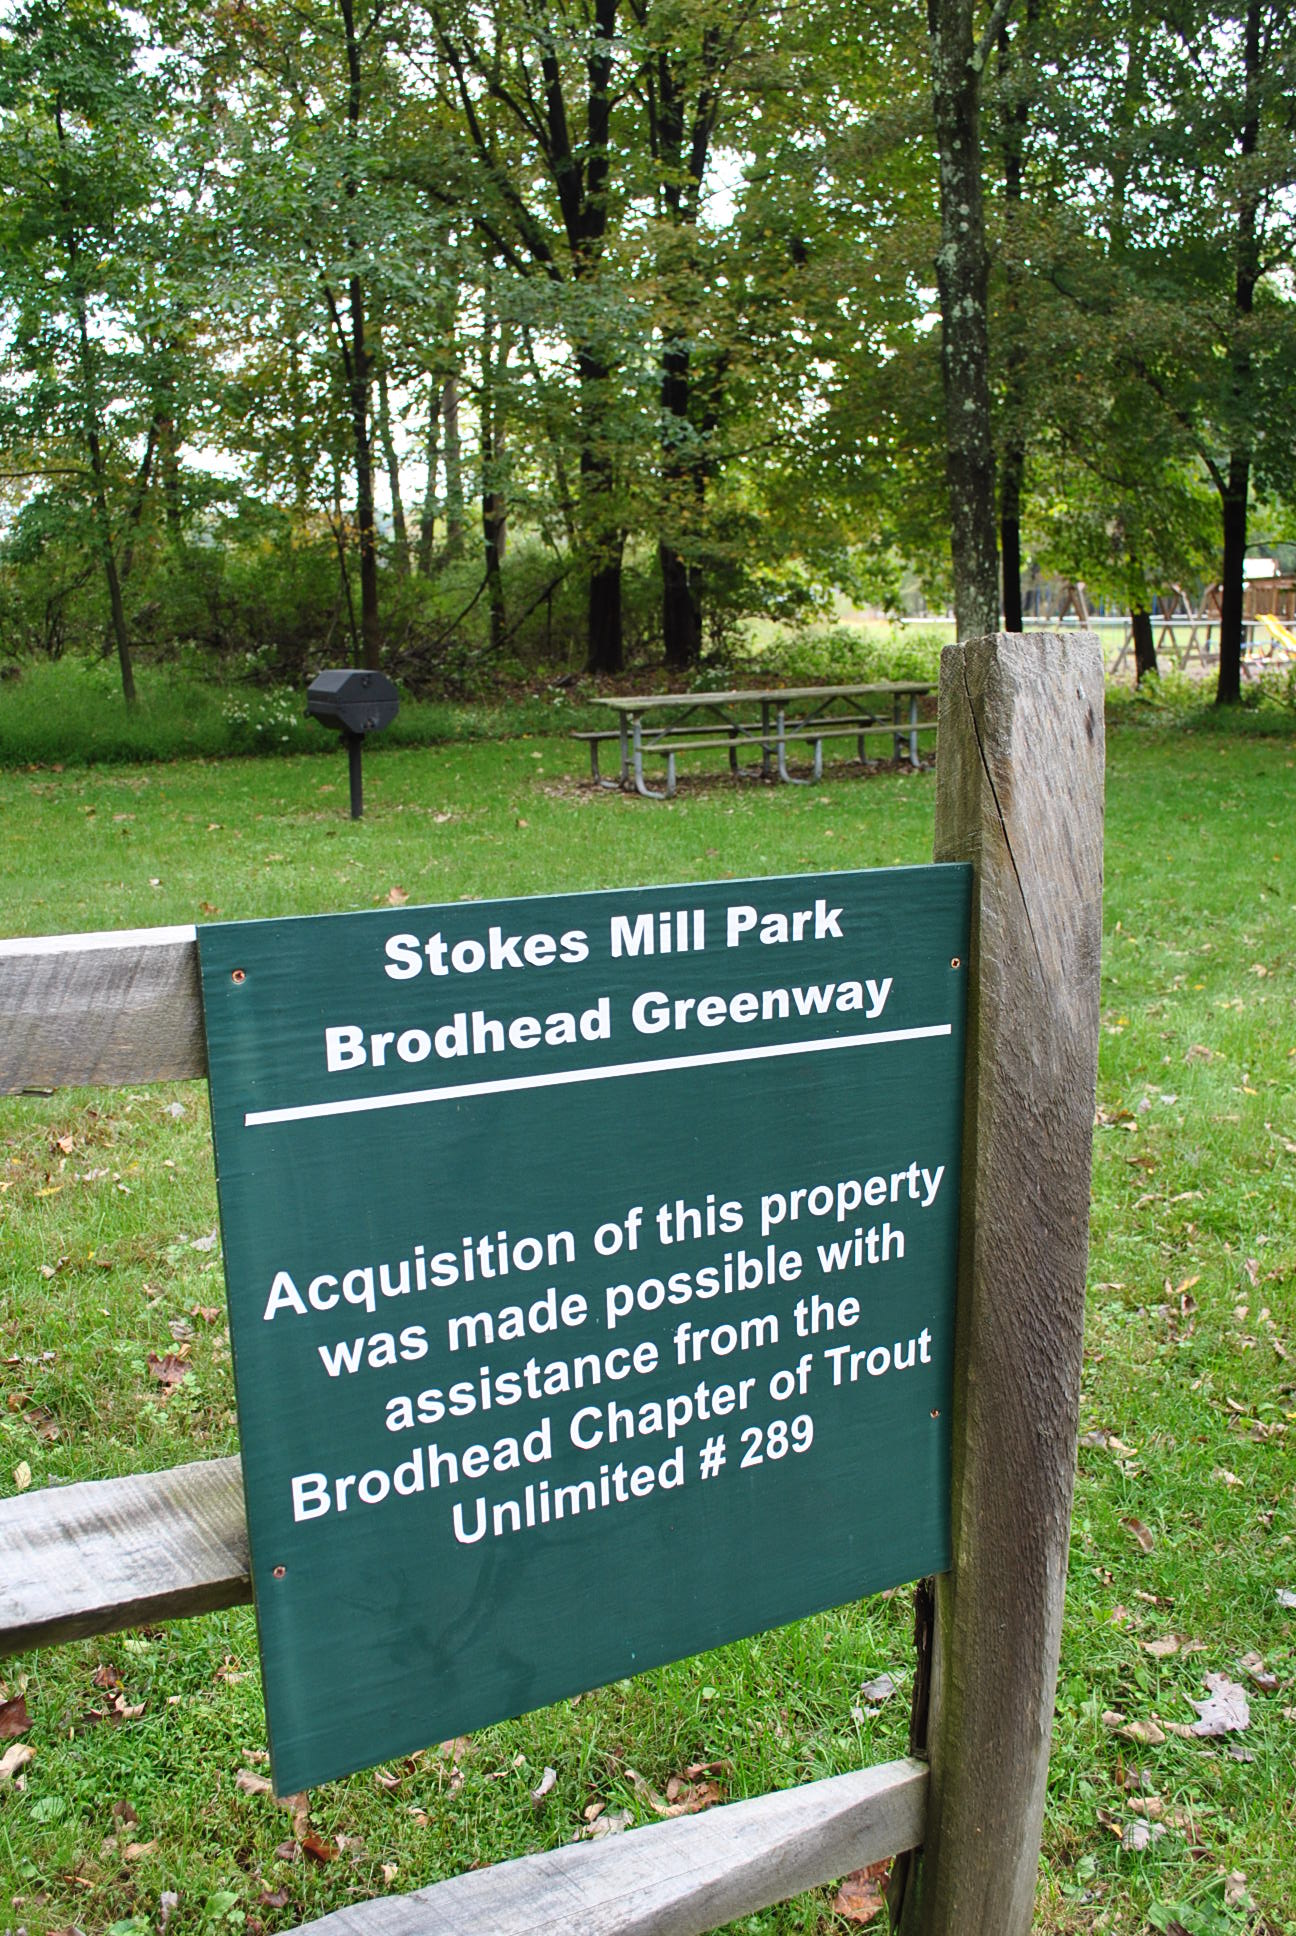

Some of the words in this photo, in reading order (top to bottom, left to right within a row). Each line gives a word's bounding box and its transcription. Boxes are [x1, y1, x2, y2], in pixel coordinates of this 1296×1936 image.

[384, 926, 590, 980] Stokes
[610, 909, 705, 958] Mill
[726, 899, 844, 948] Park
[325, 996, 611, 1073] Brodhead
[631, 977, 894, 1034] Greenway
[263, 1230, 576, 1321] Acquisition
[593, 1206, 644, 1256] of
[655, 1194, 744, 1245] this
[761, 1161, 945, 1237] property
[317, 1325, 429, 1377] was
[448, 1287, 588, 1352] made
[606, 1243, 803, 1330] possible
[816, 1222, 905, 1273] with
[291, 1417, 552, 1523] Brodhead
[569, 1371, 756, 1450] Chapter
[769, 1353, 813, 1401] of
[823, 1327, 932, 1386] Trout
[385, 1341, 659, 1432] assistance
[673, 1314, 779, 1365] from
[793, 1294, 861, 1337] the
[452, 1445, 685, 1544] Unlimited
[699, 1434, 727, 1480] #
[740, 1414, 814, 1469] 289
